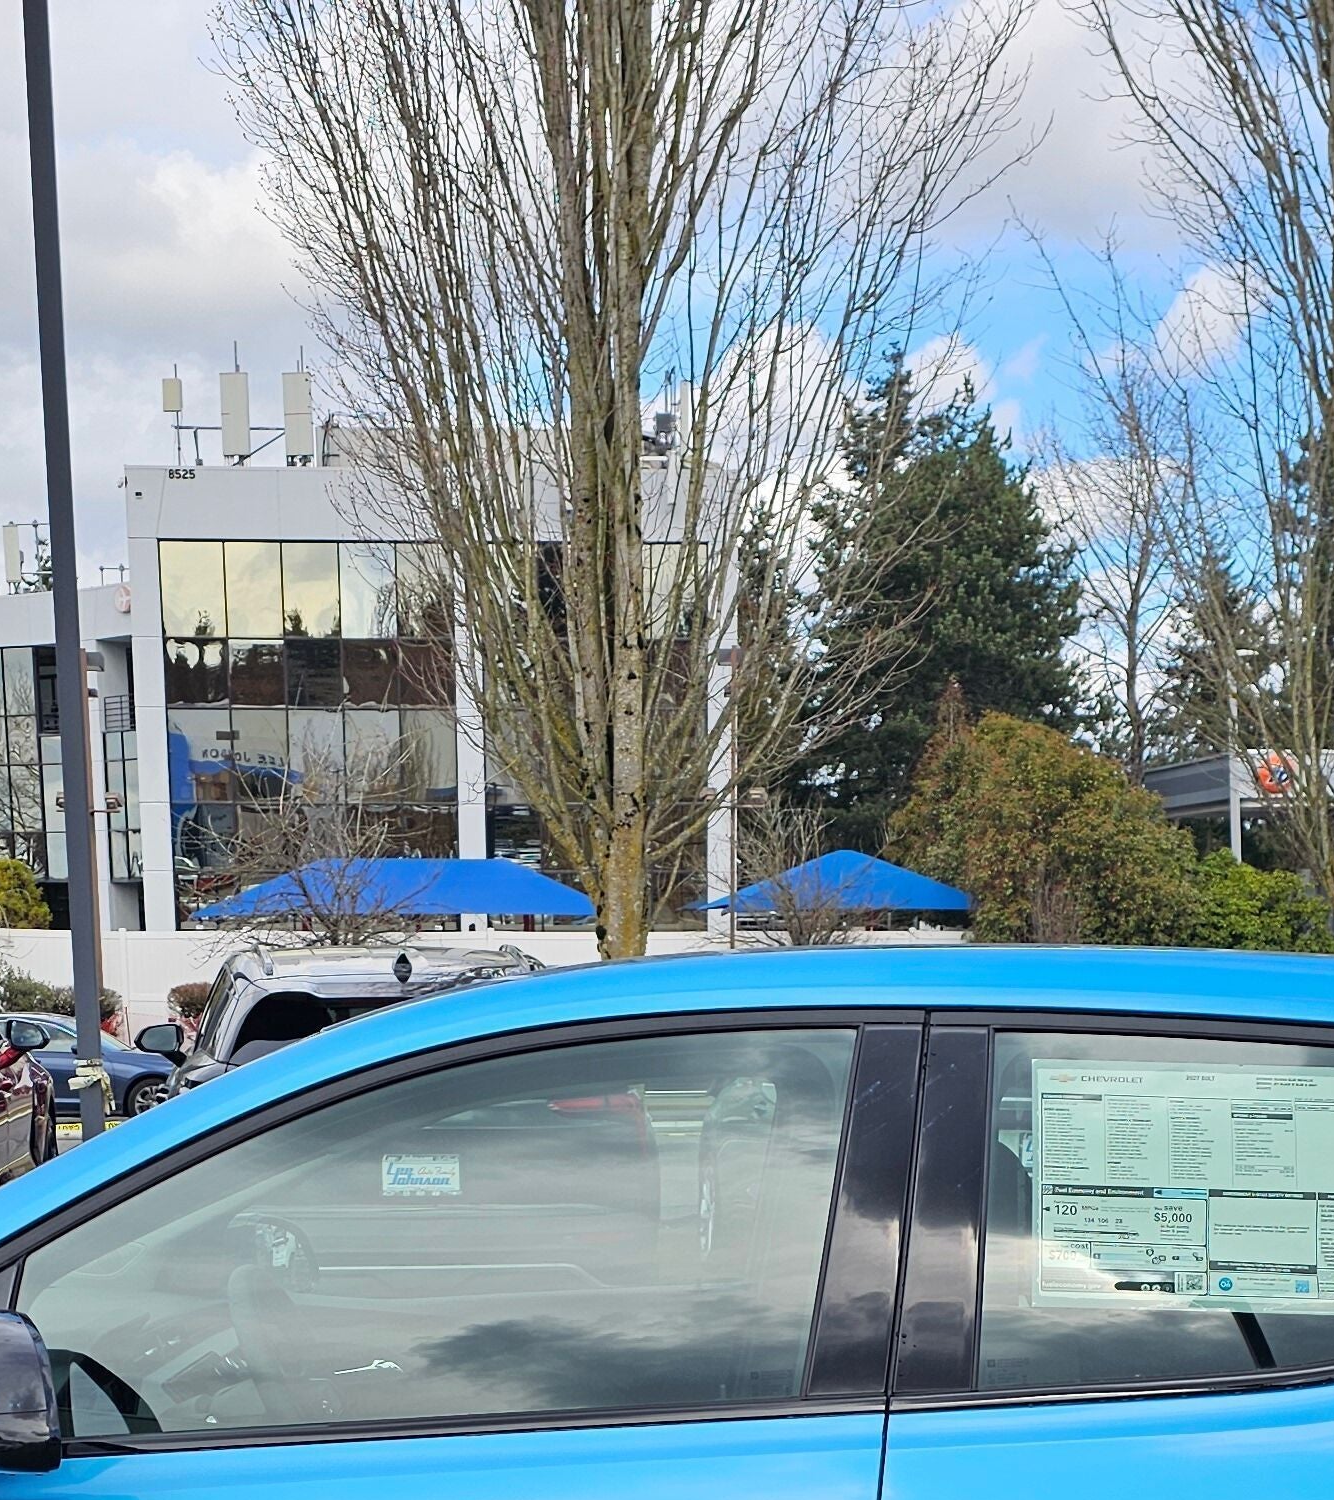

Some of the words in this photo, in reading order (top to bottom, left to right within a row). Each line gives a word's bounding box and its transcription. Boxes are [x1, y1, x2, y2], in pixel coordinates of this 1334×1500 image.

[168, 469, 196, 479] 8525
[1081, 1075, 1144, 1084] CHEVROLET
[388, 1174, 451, 1185] Johnson
[1054, 1205, 1077, 1216] 120
[1153, 1212, 1193, 1224] $5,000
